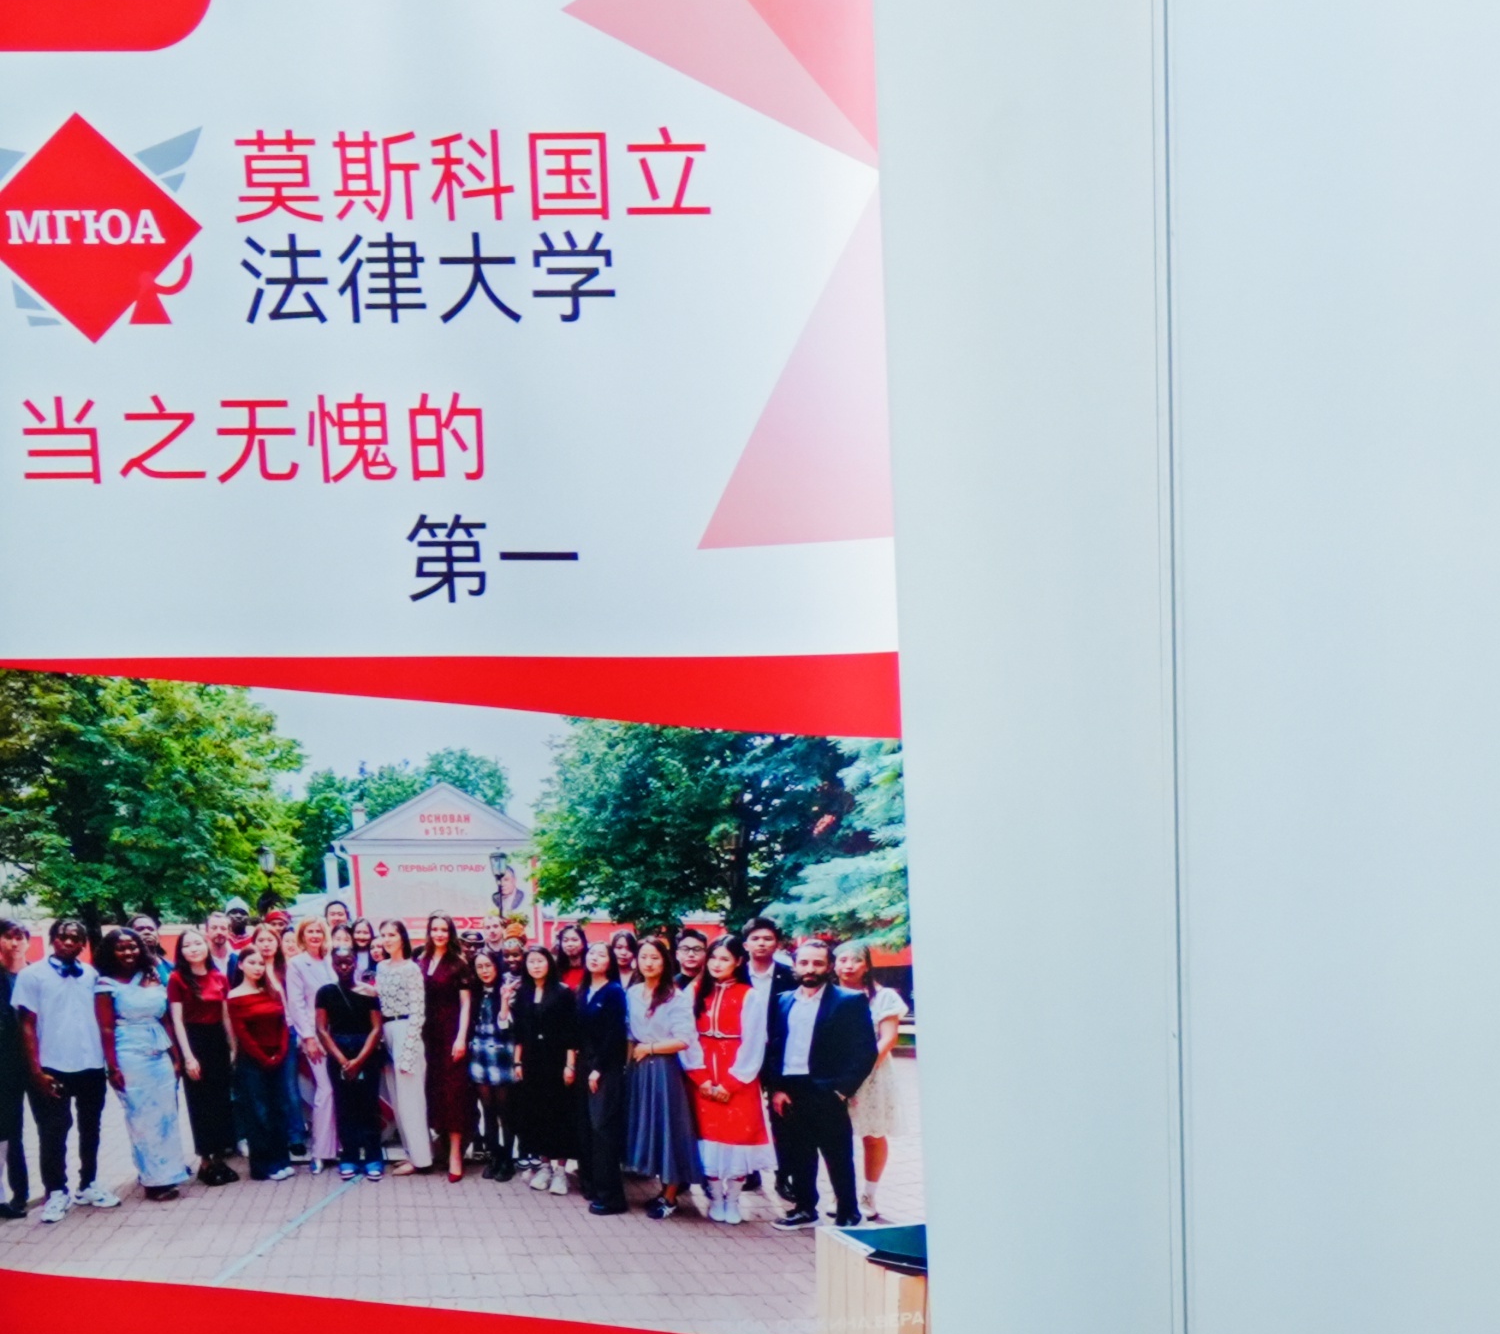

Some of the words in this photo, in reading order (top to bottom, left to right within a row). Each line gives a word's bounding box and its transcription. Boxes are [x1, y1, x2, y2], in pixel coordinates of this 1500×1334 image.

[234, 126, 713, 224] 莫斯科国立
[6, 208, 166, 246] МГЮА
[238, 229, 617, 324] 法律大学
[21, 392, 486, 484] 当之无愧的
[406, 513, 580, 605] 第一
[420, 814, 470, 823] ОСНОВАН
[398, 863, 438, 873] ПЕРВЫЙ
[441, 865, 454, 873] ПО
